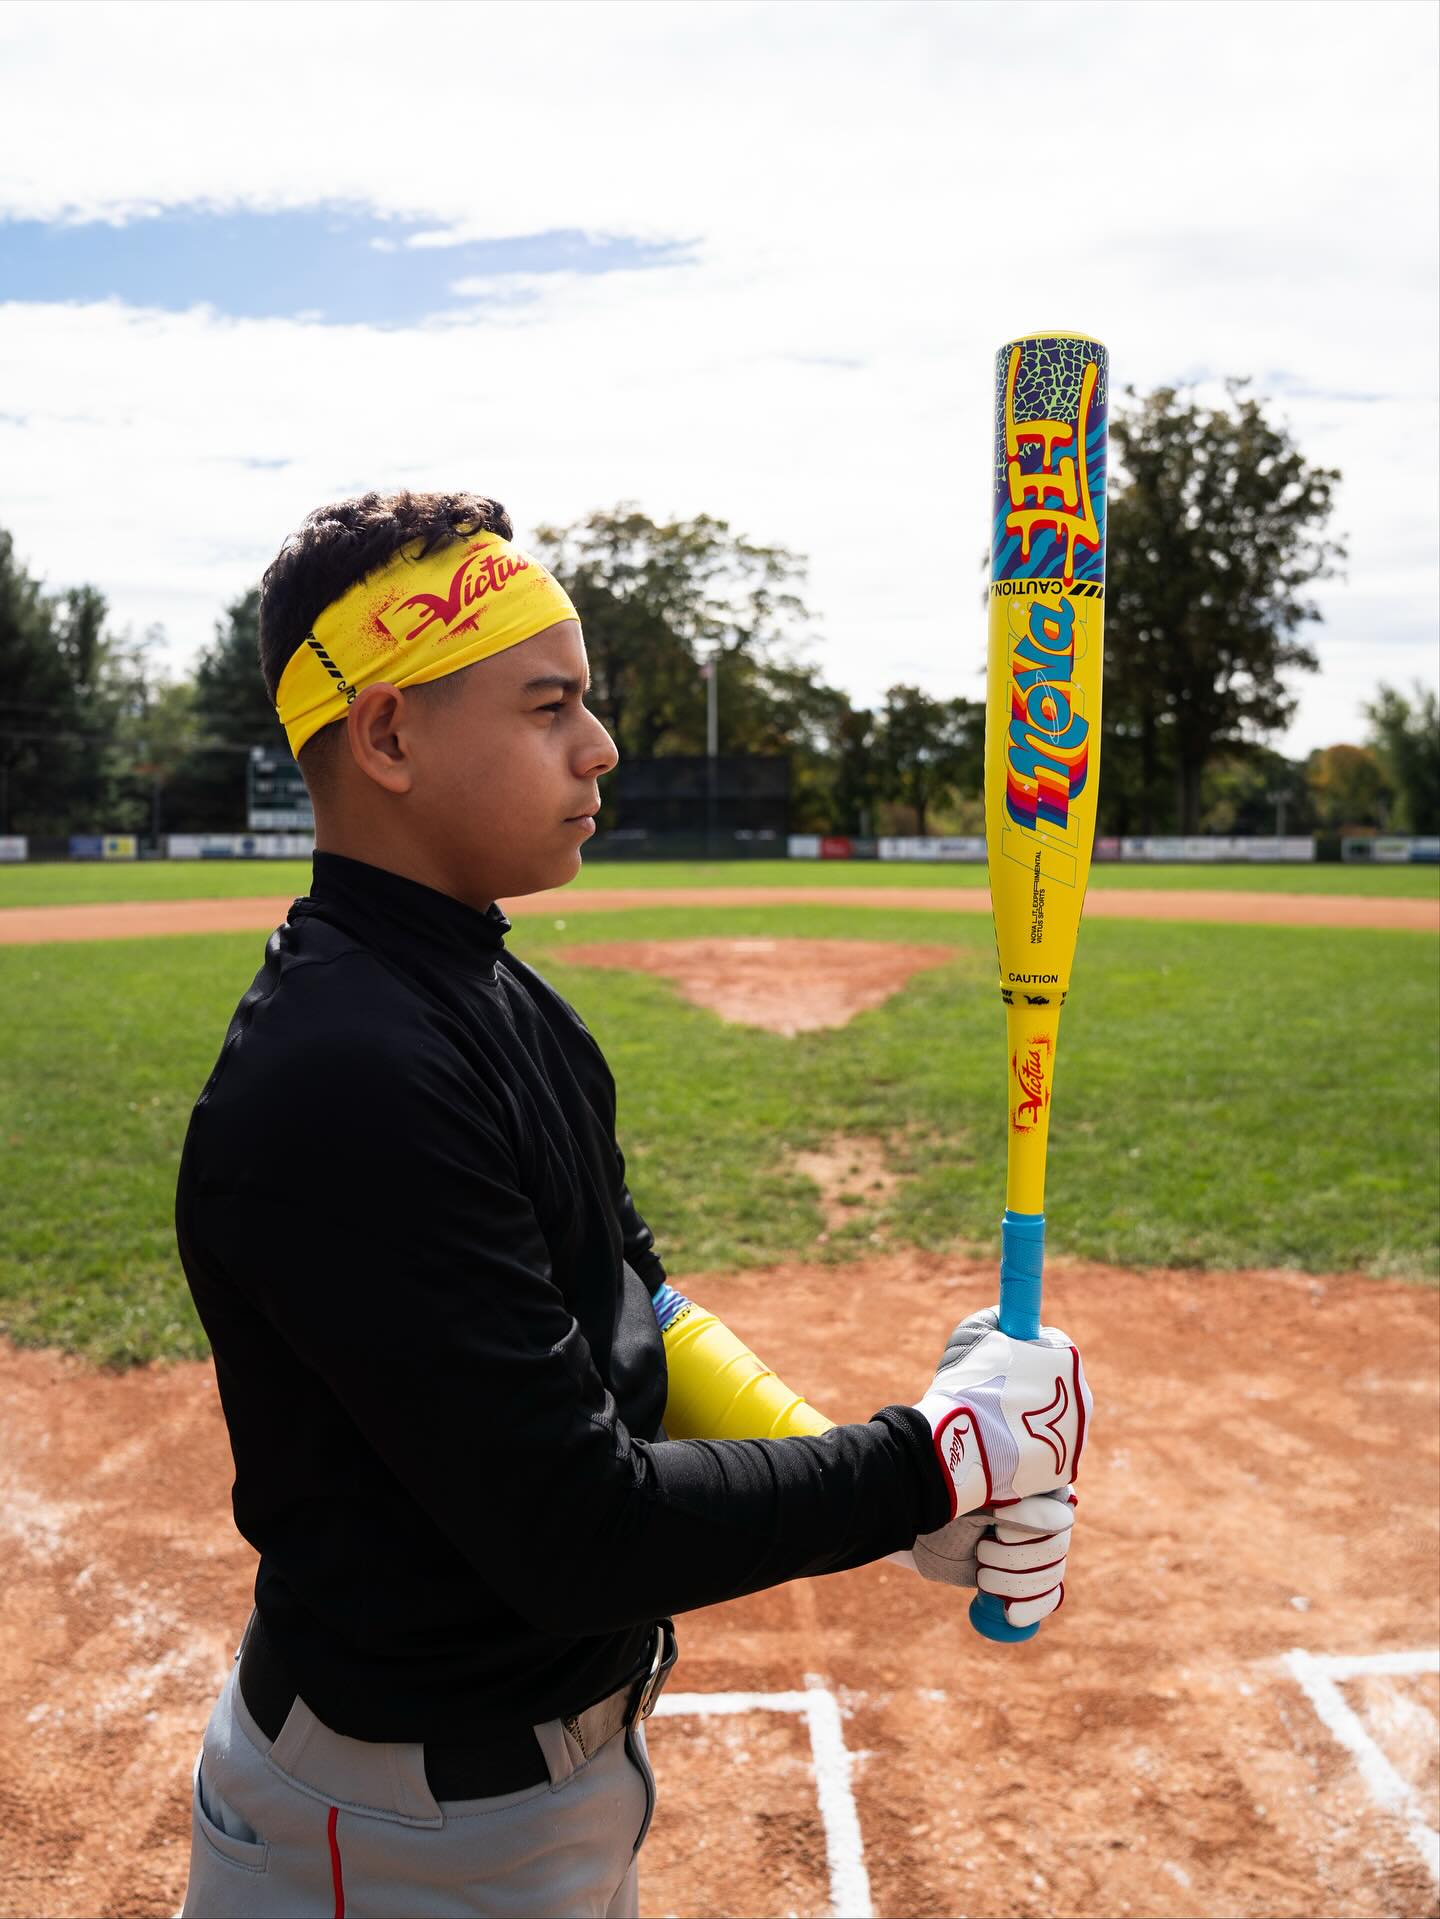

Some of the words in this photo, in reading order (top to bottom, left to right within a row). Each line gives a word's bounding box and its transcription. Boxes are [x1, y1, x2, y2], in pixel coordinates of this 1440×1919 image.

[392, 553, 530, 641] Victus
[994, 580, 1063, 596] CAUTION
[1038, 888, 1046, 919] SPORTS
[1036, 920, 1044, 944] VICTUS
[1008, 972, 1059, 984] CAUTION
[1017, 1050, 1045, 1124] Victus
[949, 1423, 970, 1473] Victus
